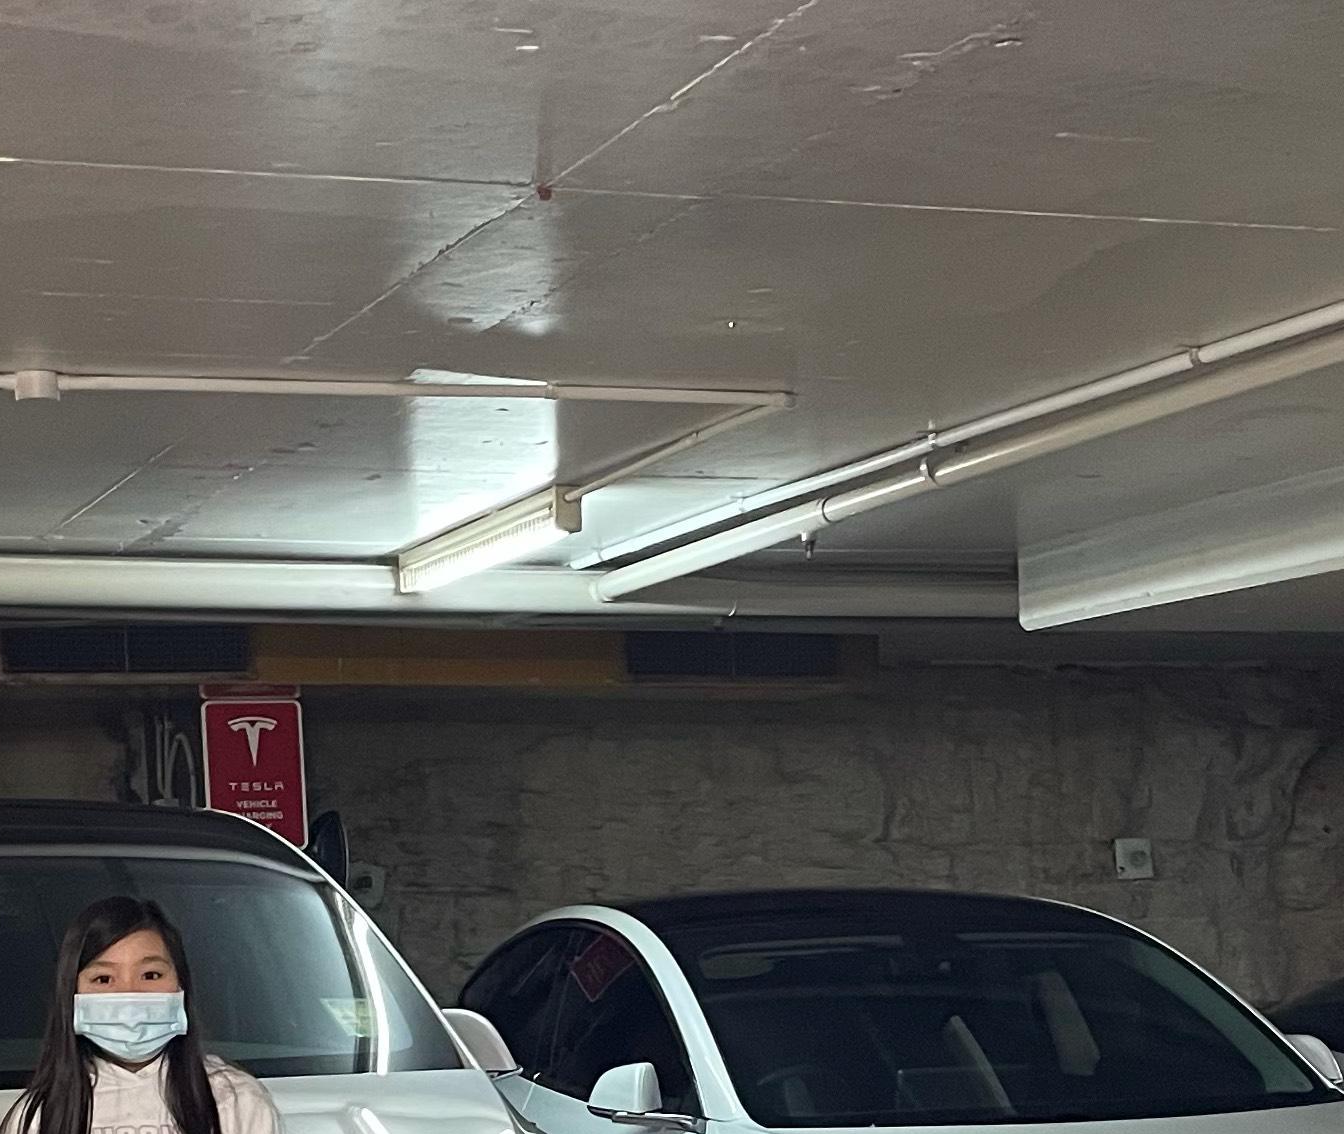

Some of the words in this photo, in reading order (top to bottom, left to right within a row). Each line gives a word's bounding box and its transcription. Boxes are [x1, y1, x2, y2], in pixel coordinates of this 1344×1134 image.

[229, 781, 285, 792] TESLA
[236, 799, 278, 808] VEHICLE
[241, 811, 284, 820] ARGING
